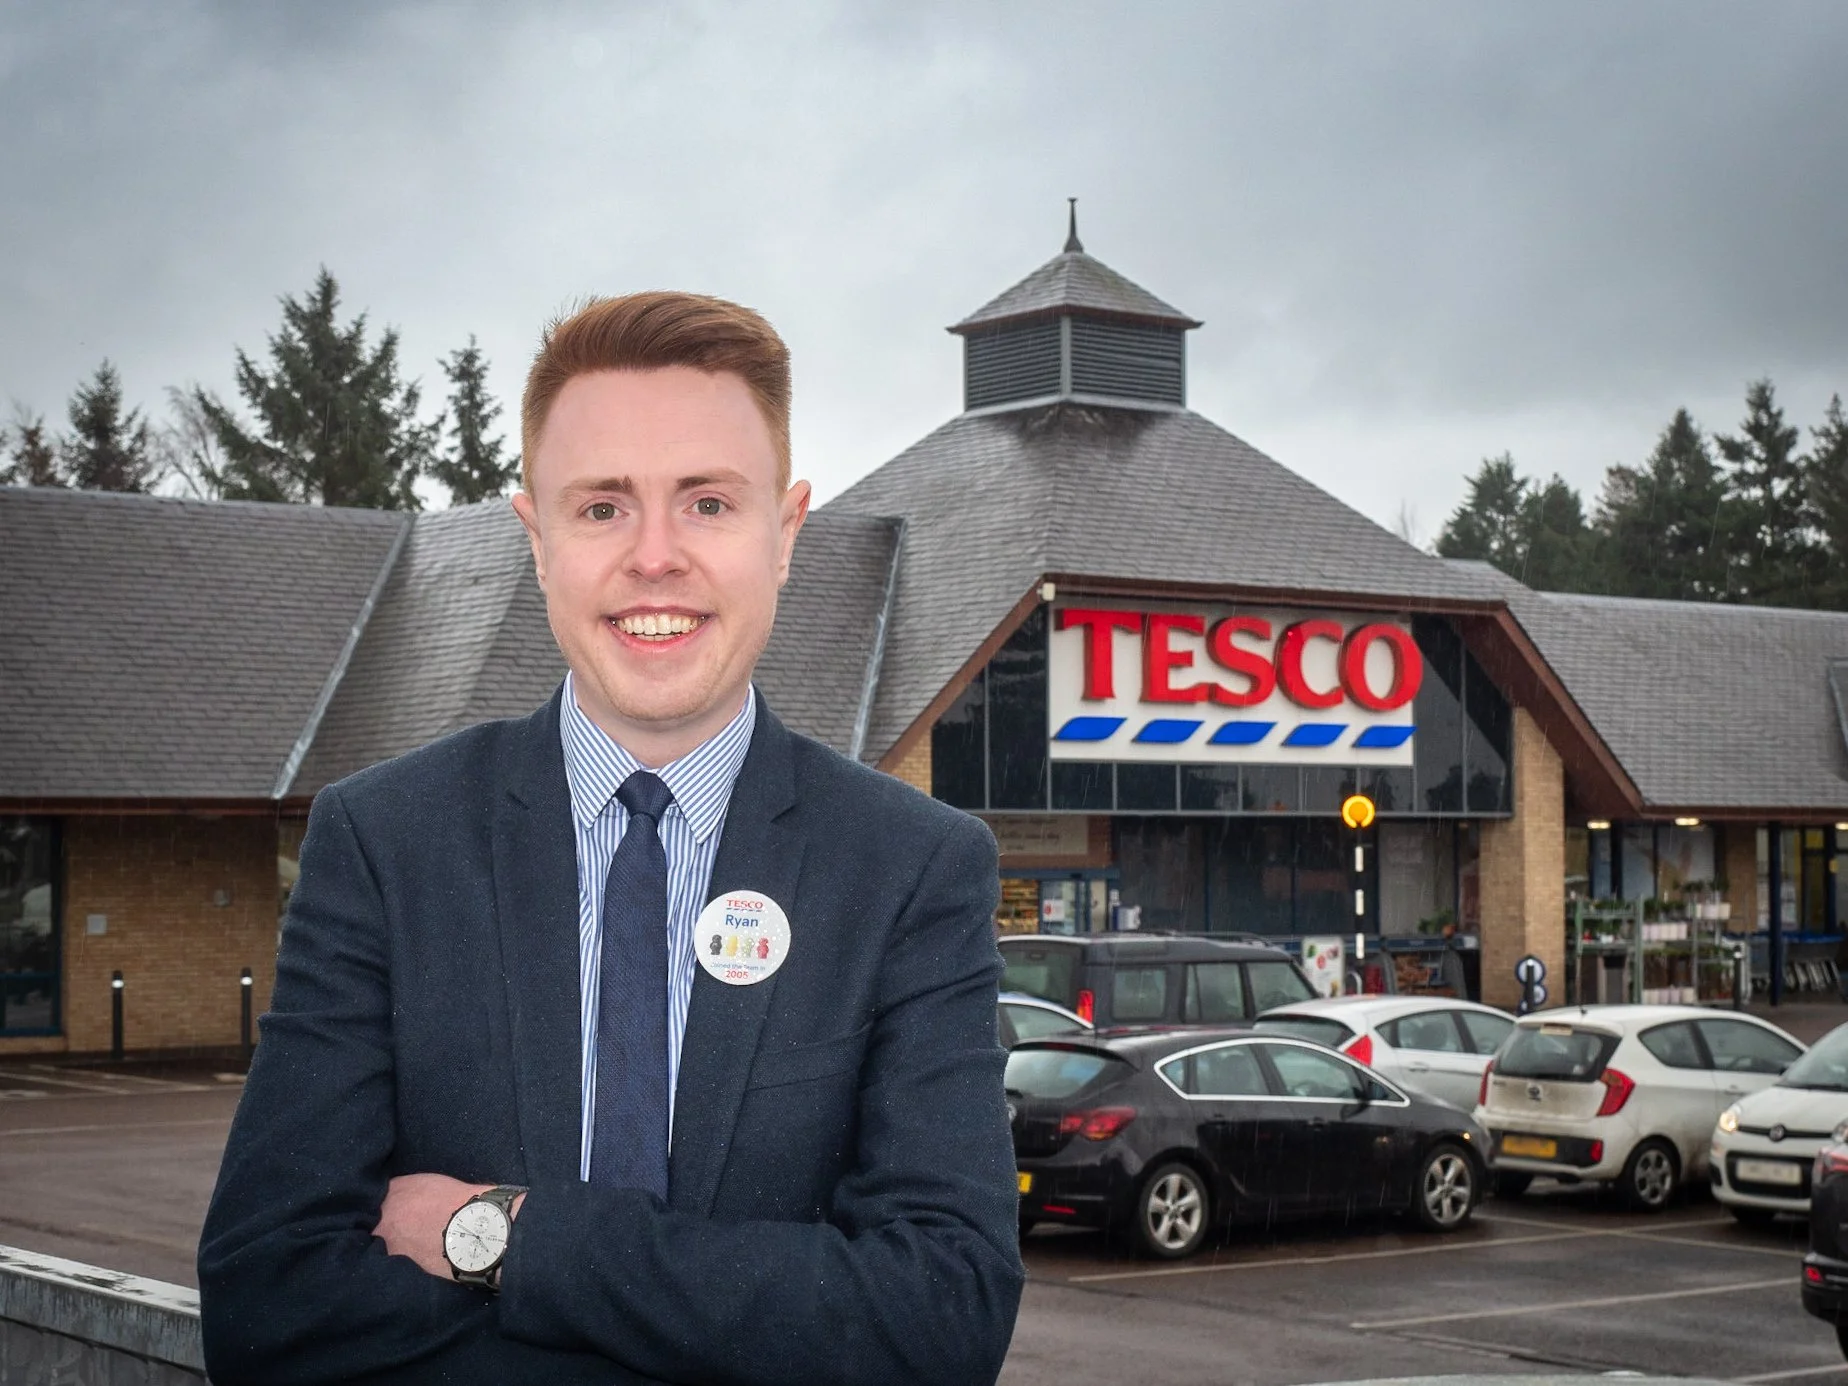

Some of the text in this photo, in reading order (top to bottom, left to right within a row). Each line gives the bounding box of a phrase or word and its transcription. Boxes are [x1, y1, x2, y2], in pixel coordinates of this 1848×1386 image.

[1055, 608, 1424, 712] TESCO
[726, 899, 764, 909] TESCO
[725, 914, 759, 929] Ryan
[726, 970, 749, 979] 2005
